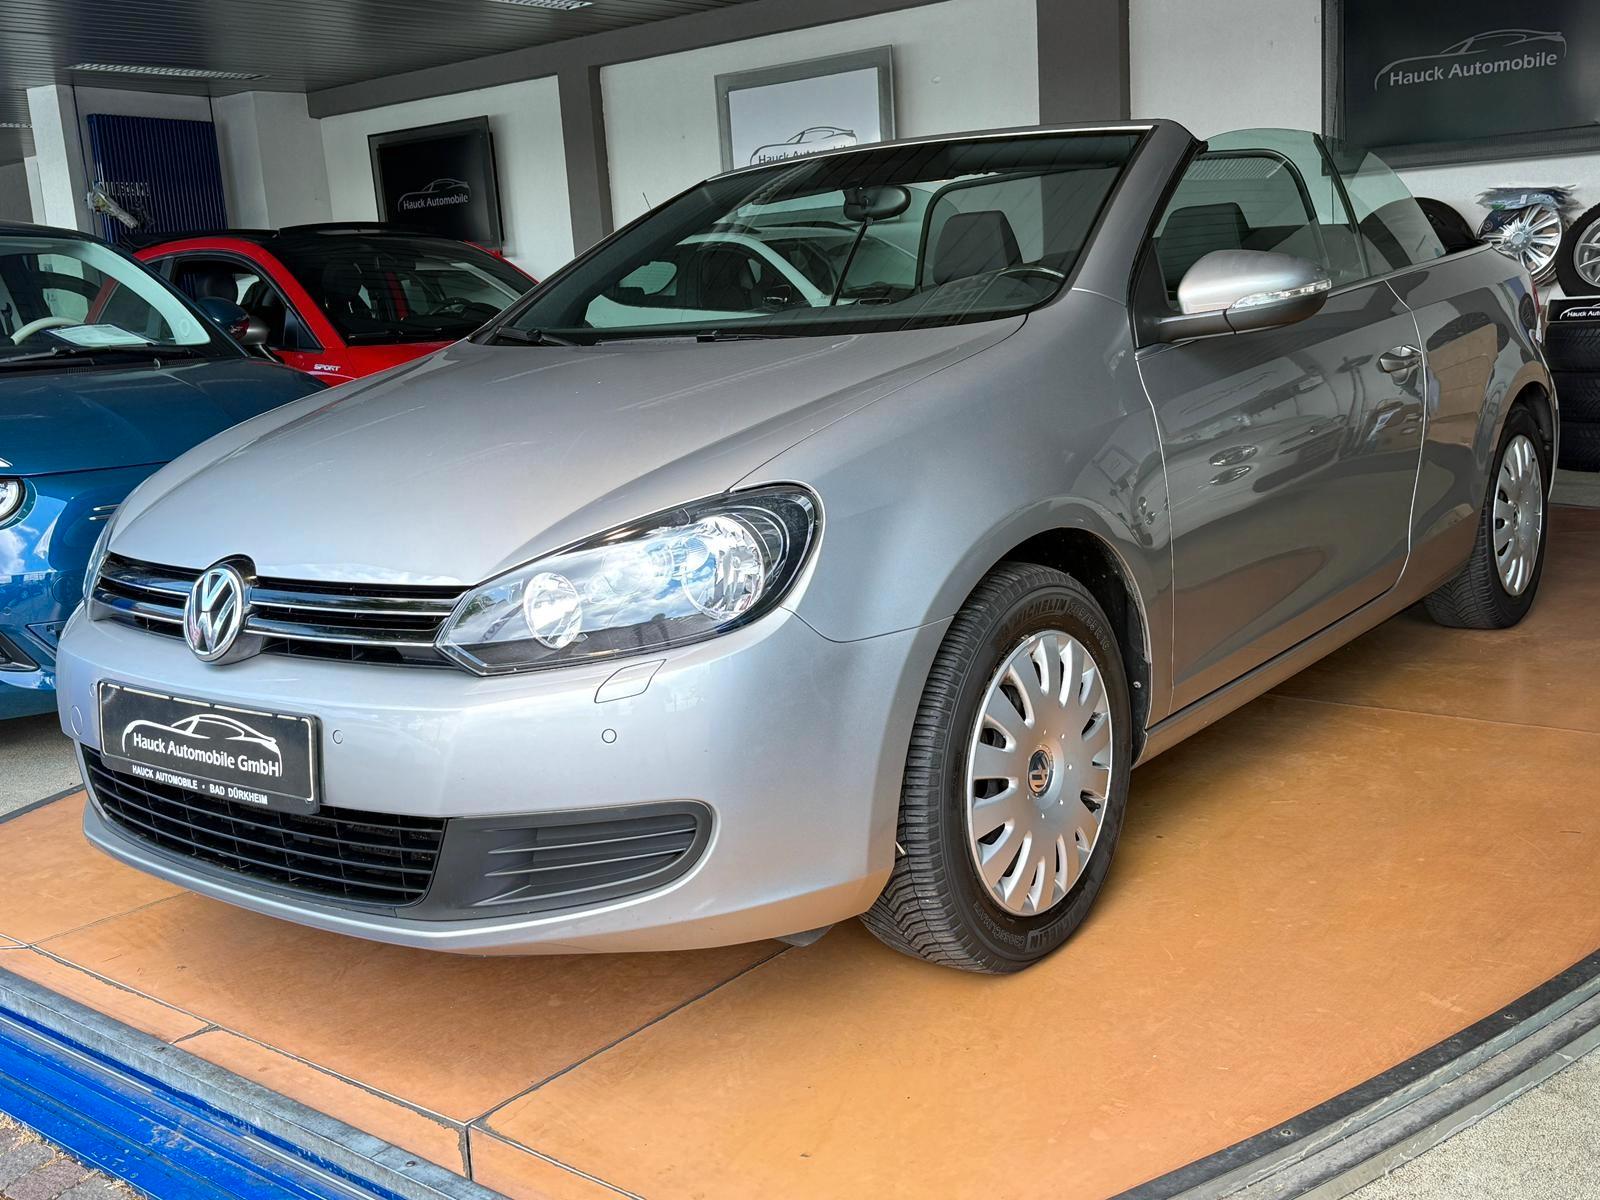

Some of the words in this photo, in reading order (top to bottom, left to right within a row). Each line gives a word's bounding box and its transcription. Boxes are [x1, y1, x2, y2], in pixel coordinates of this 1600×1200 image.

[1389, 66, 1444, 86] Hauck
[1448, 52, 1558, 79] Automobile
[403, 199, 425, 210] Hauck
[426, 193, 468, 207] Automobile
[314, 363, 341, 371] SPORT
[133, 731, 166, 754] Hauck
[167, 741, 235, 769] Automobile
[237, 755, 279, 777] GmbH
[132, 764, 154, 779] HAUCK
[155, 771, 198, 790] AUTOMOBILE
[209, 785, 225, 796] BAD
[228, 787, 268, 805] DÜRKHEIM
